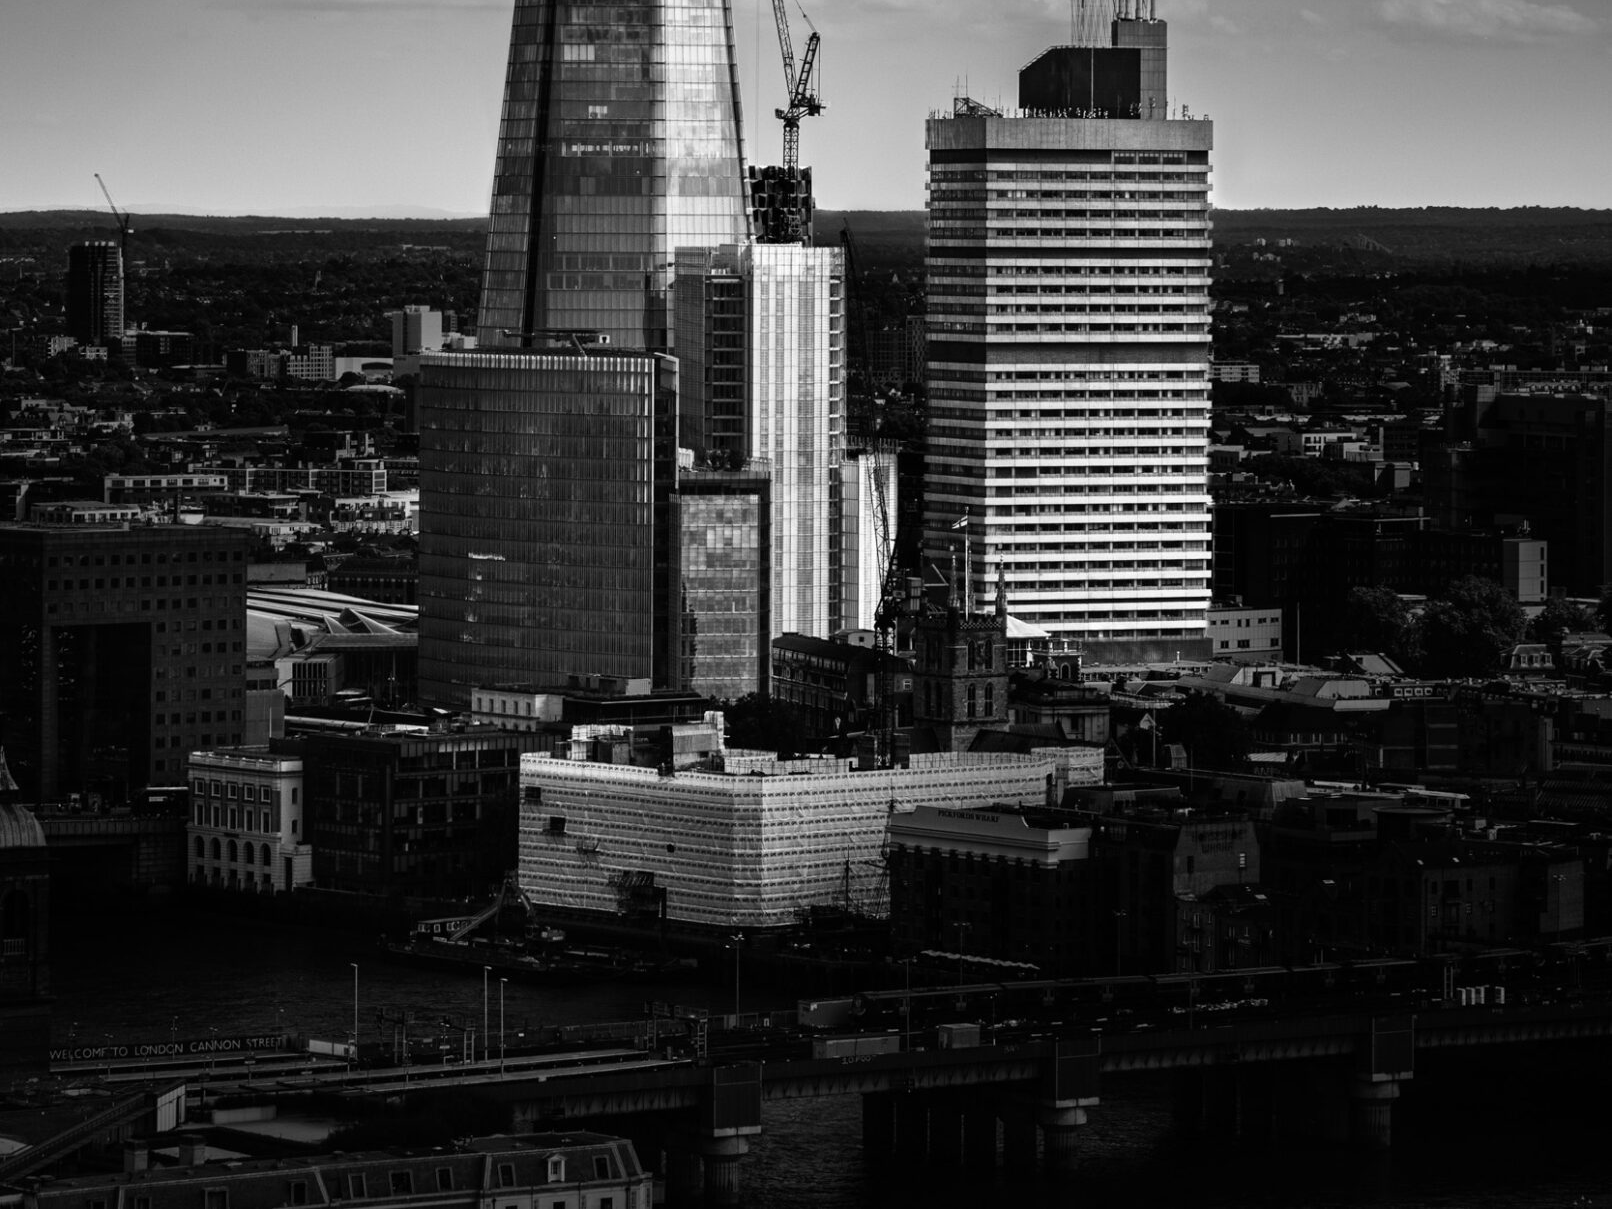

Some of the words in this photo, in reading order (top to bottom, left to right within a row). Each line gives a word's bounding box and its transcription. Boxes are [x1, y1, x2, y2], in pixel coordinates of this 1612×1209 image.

[975, 813, 1000, 823] WHARF
[49, 1047, 108, 1060] WELCOME
[111, 1046, 128, 1057] TO
[134, 1043, 183, 1056] LONDON
[190, 1039, 241, 1053] CANNON
[246, 1037, 283, 1048] STREET
